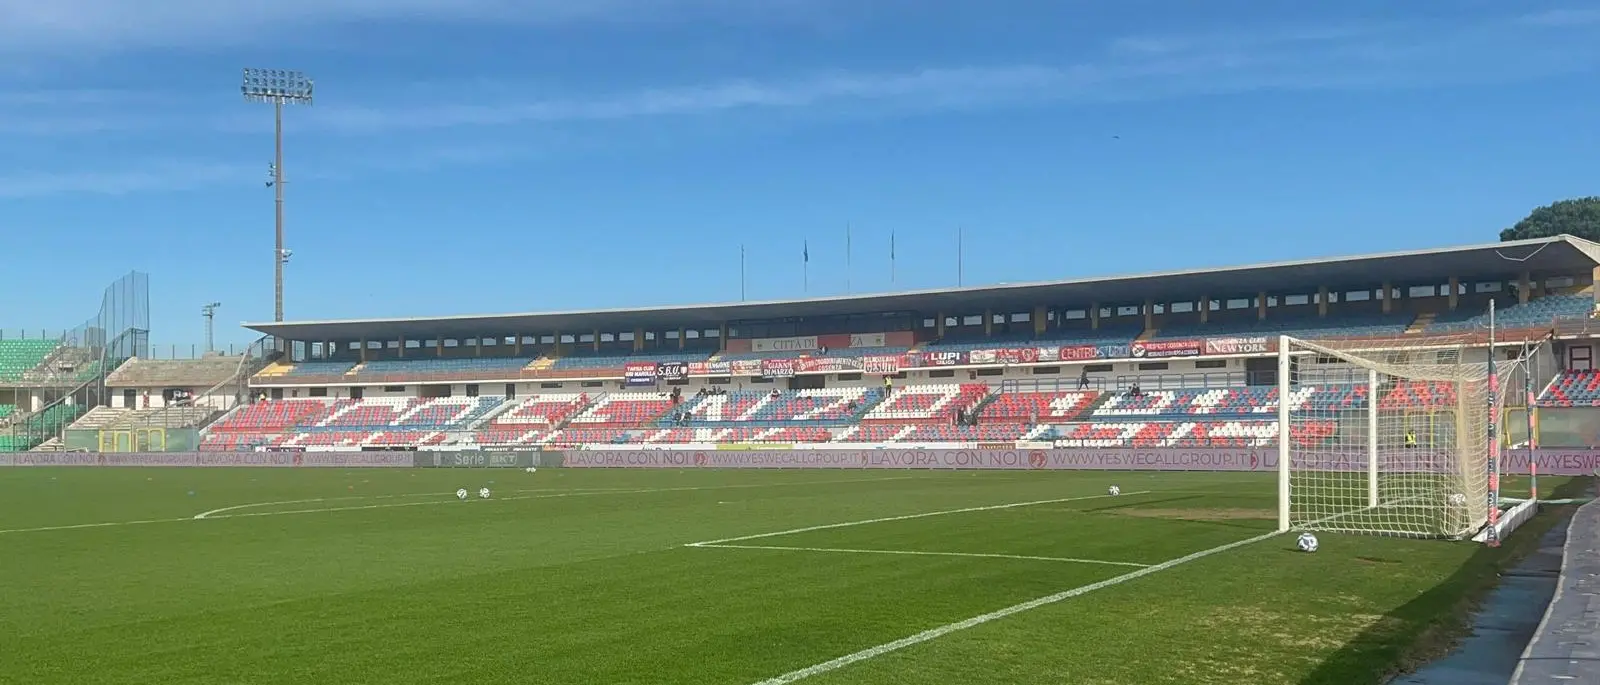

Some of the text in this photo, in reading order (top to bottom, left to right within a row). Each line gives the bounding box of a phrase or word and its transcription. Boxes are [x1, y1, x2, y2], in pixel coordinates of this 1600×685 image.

[804, 337, 815, 349] DI
[1209, 341, 1267, 353] NEW YORK
[930, 352, 960, 361] LUPI
[1061, 347, 1097, 360] CENTRO
[771, 368, 794, 376] MARZO
[202, 452, 289, 464] LAVORA CON NOI
[455, 452, 485, 465] Serie
[570, 452, 689, 465] LAVORA CON NOI
[712, 452, 859, 465] WWW.YESWECALLGROUP.IT
[872, 451, 1023, 465] LAVORA CON NOI
[1053, 452, 1248, 465] WWW.YESWECALLGROUP.IT
